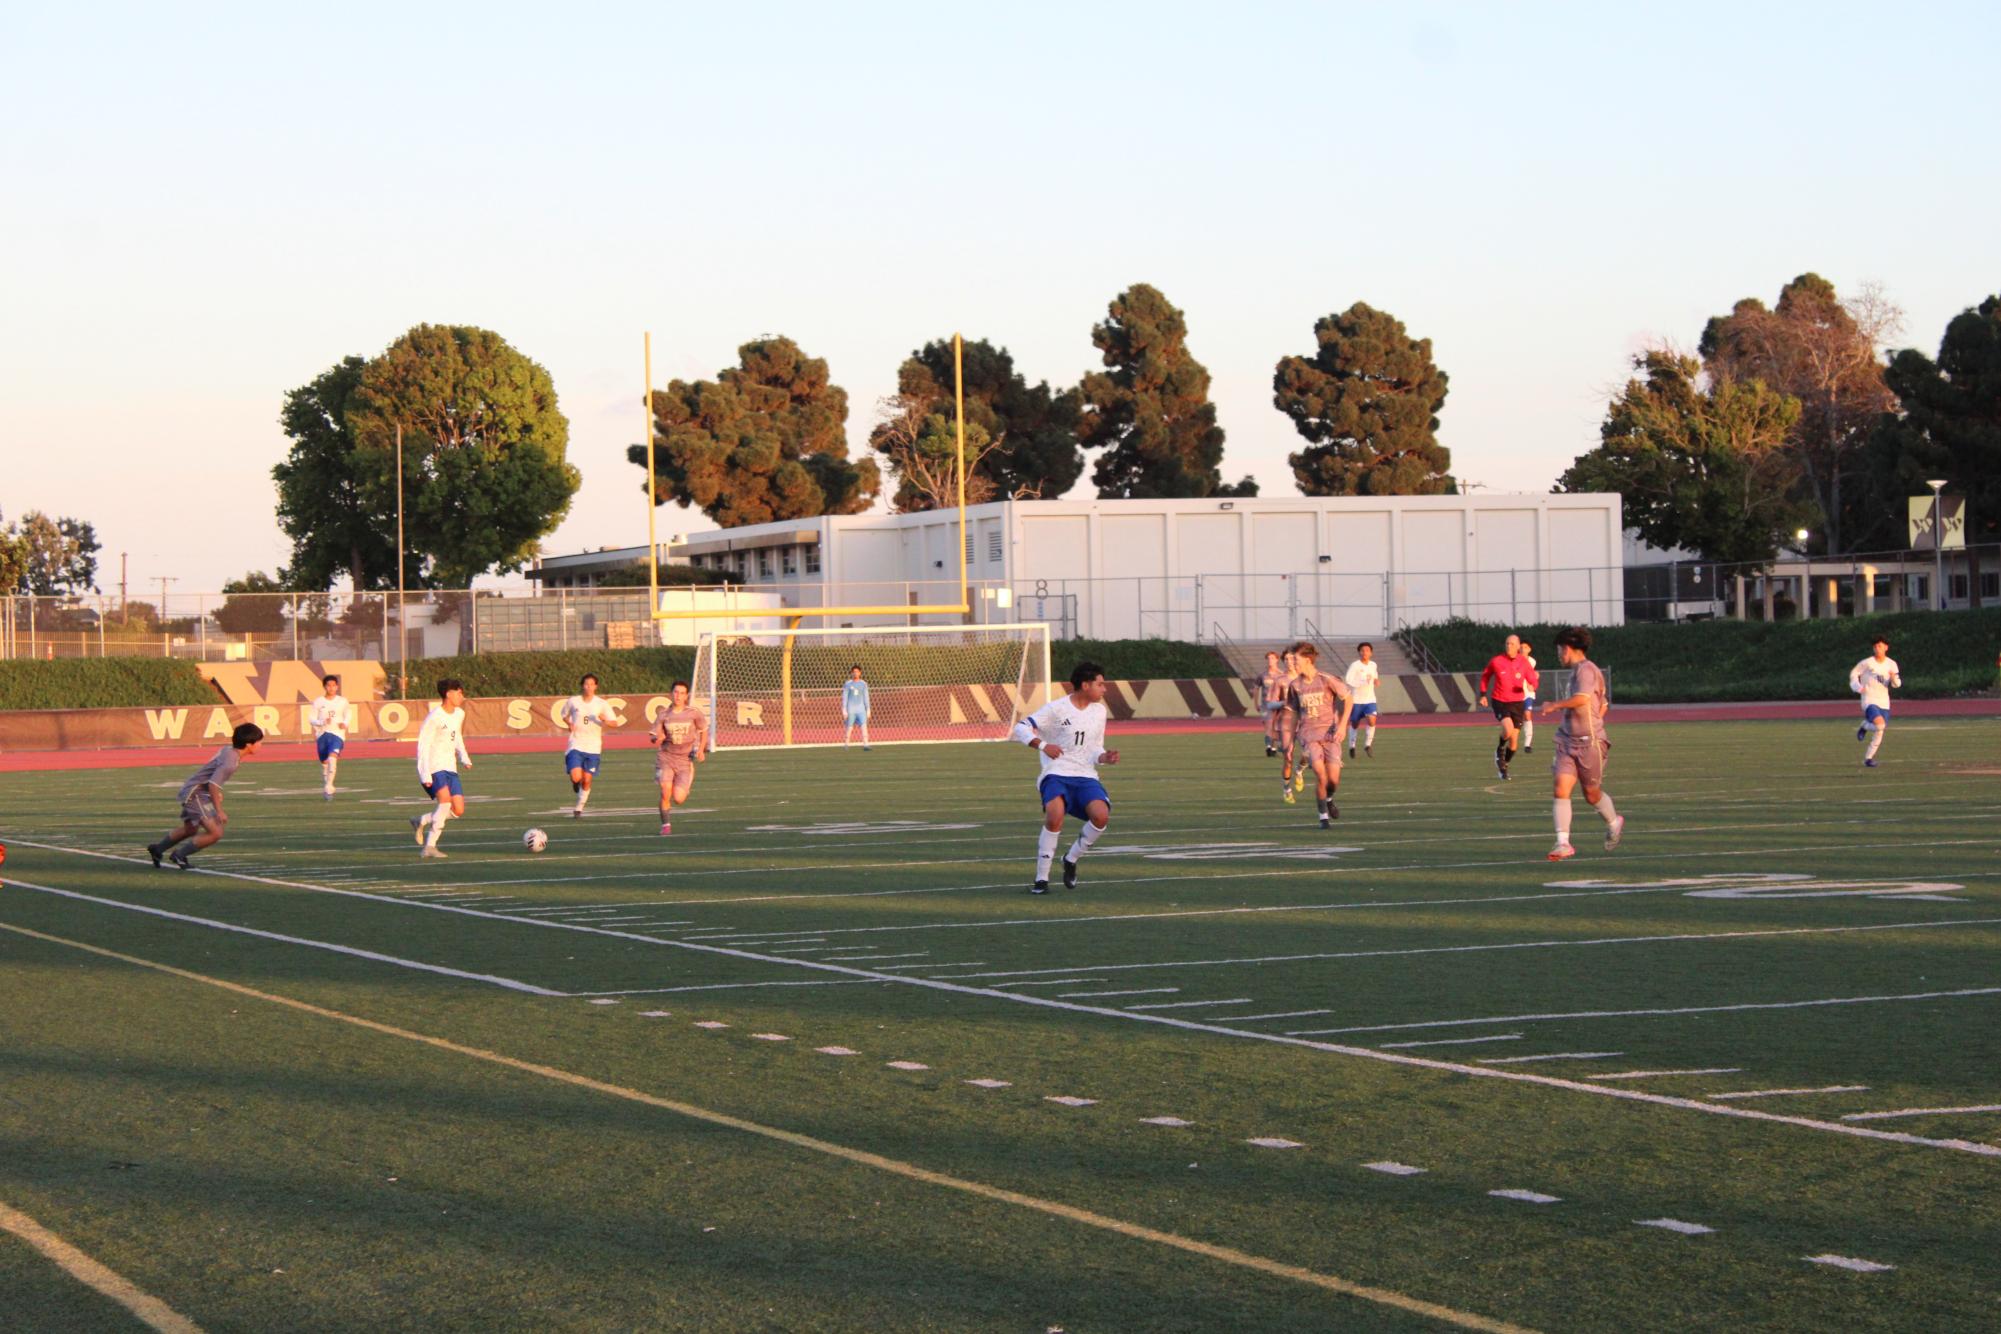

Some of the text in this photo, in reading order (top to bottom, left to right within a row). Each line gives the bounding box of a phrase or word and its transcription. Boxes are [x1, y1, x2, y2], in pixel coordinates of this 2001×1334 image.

[145, 701, 447, 740] WARIO
[583, 716, 589, 725] 6
[450, 730, 456, 741] 9
[1074, 731, 1085, 746] 11
